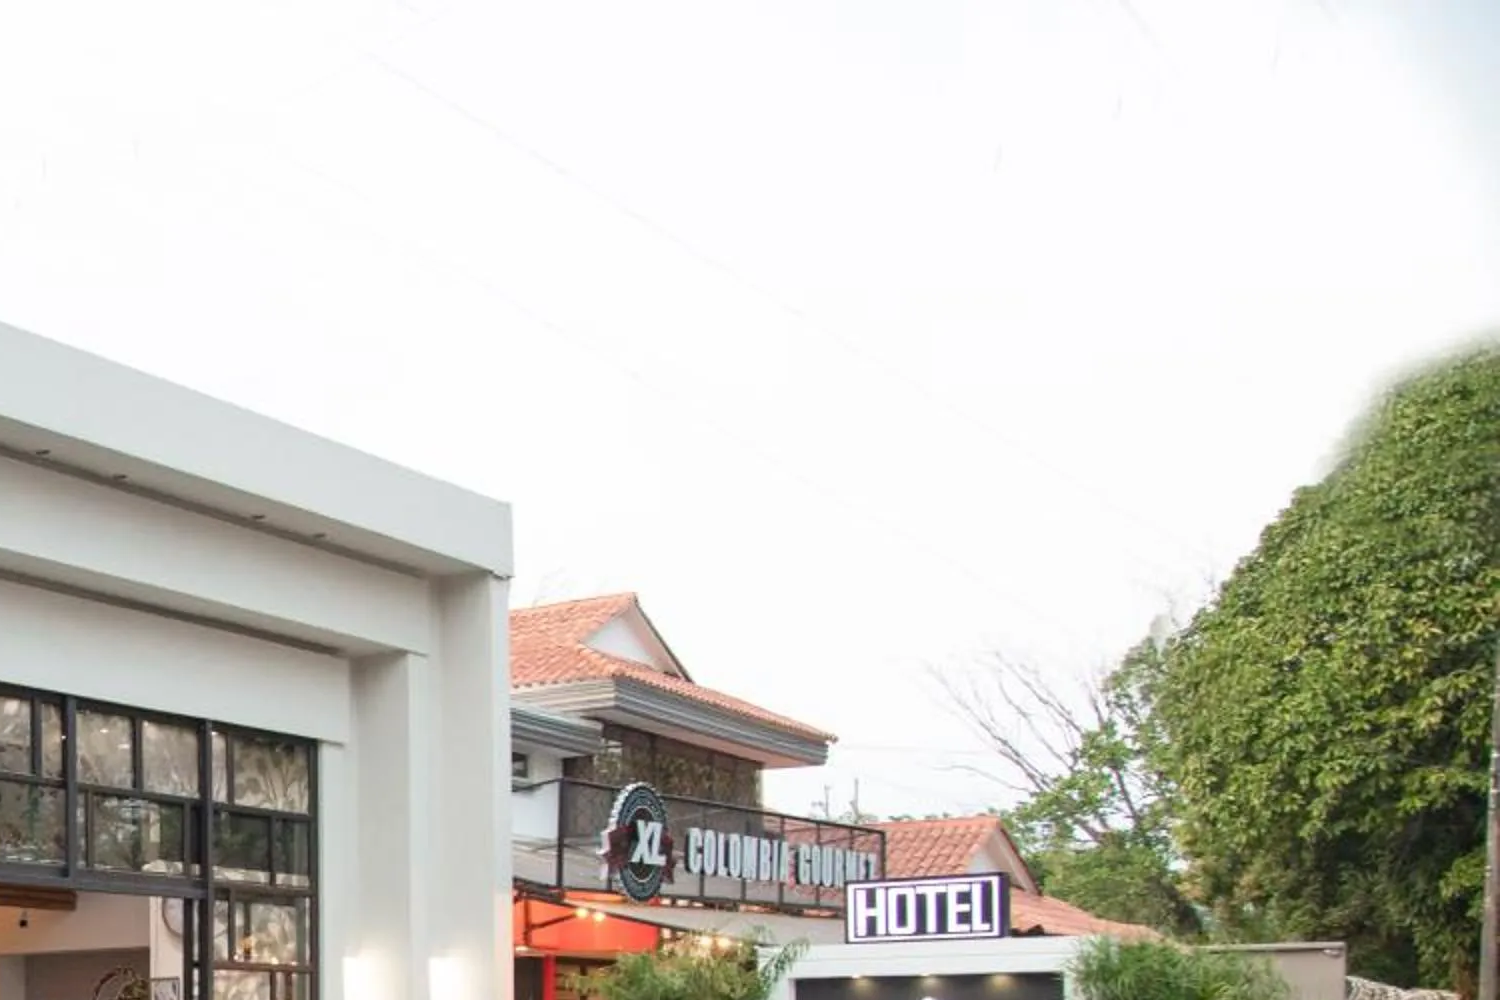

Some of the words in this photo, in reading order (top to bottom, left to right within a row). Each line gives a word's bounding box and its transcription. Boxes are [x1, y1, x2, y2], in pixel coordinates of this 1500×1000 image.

[631, 819, 667, 867] XL
[687, 826, 790, 883] COLOMBIA
[798, 842, 878, 888] GOURMET
[855, 882, 992, 938] HOTEL
